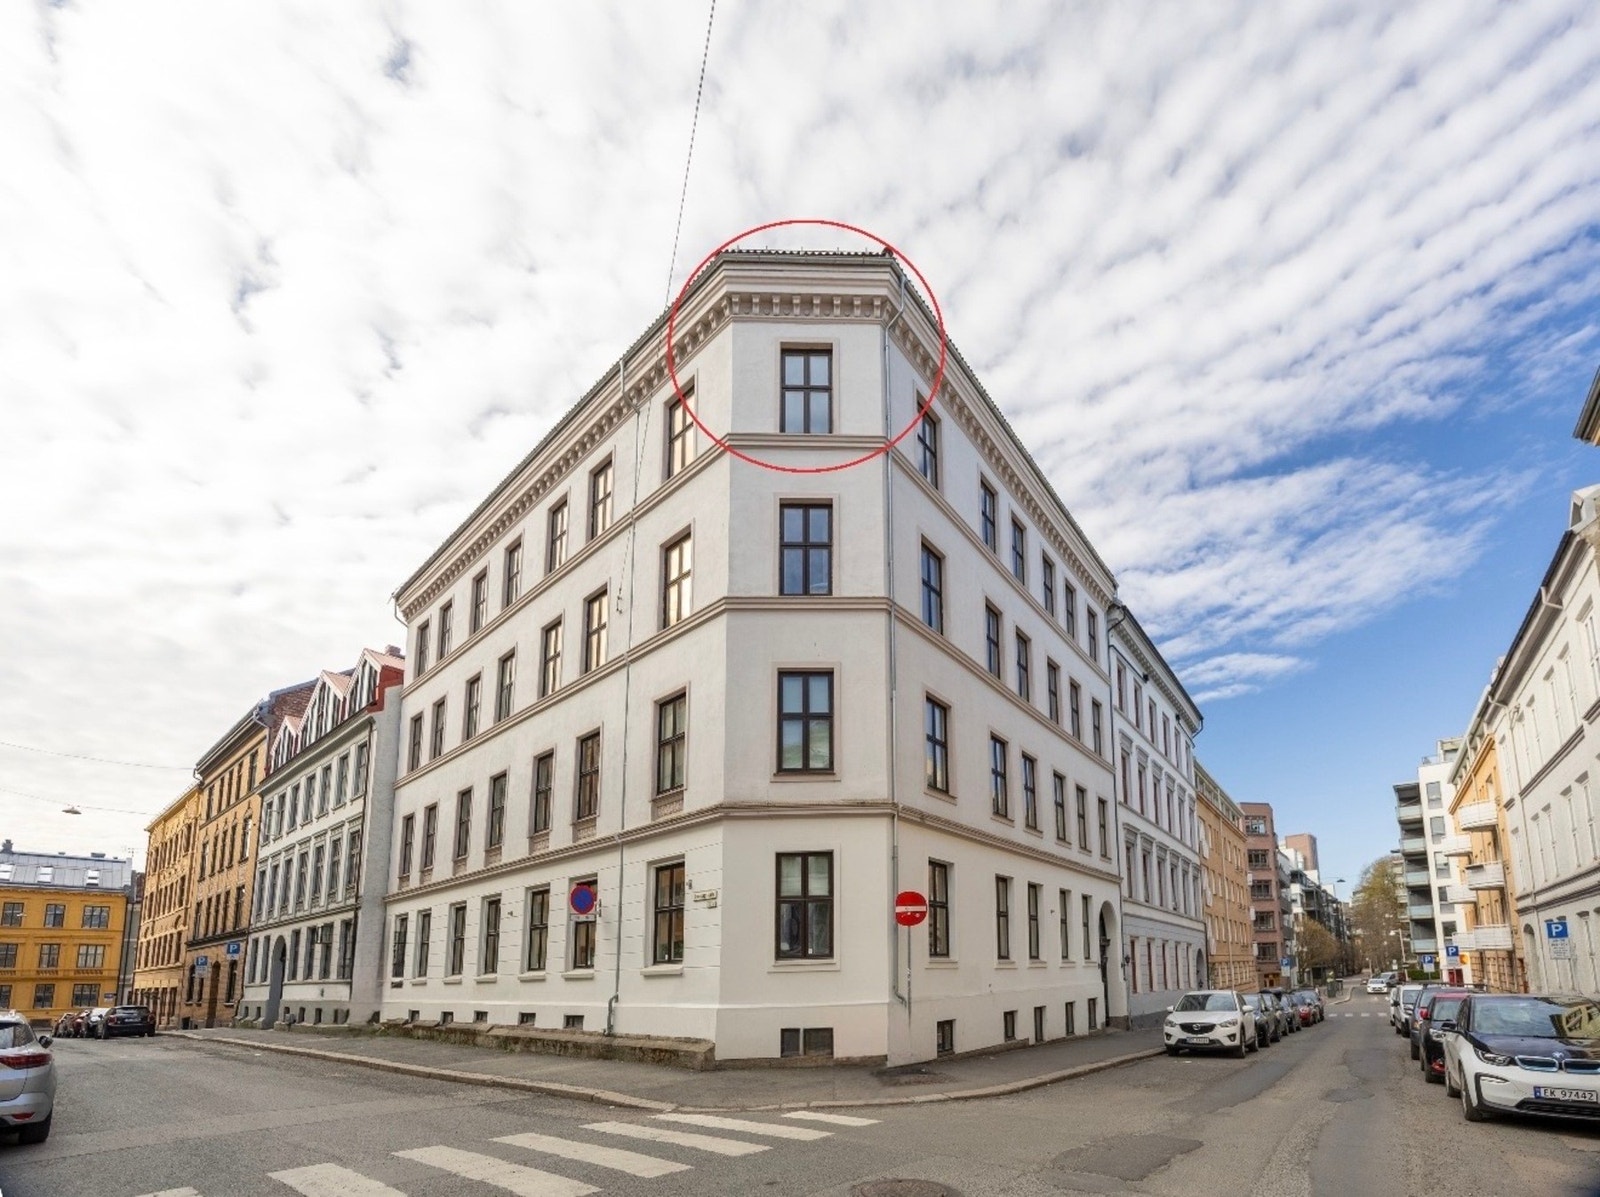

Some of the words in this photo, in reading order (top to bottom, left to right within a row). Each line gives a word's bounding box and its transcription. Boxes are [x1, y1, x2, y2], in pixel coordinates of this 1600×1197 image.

[1551, 924, 1563, 936] P
[229, 944, 238, 953] P
[1448, 946, 1457, 956] P
[1543, 1088, 1556, 1097] EK
[1560, 1090, 1594, 1101] 97442
